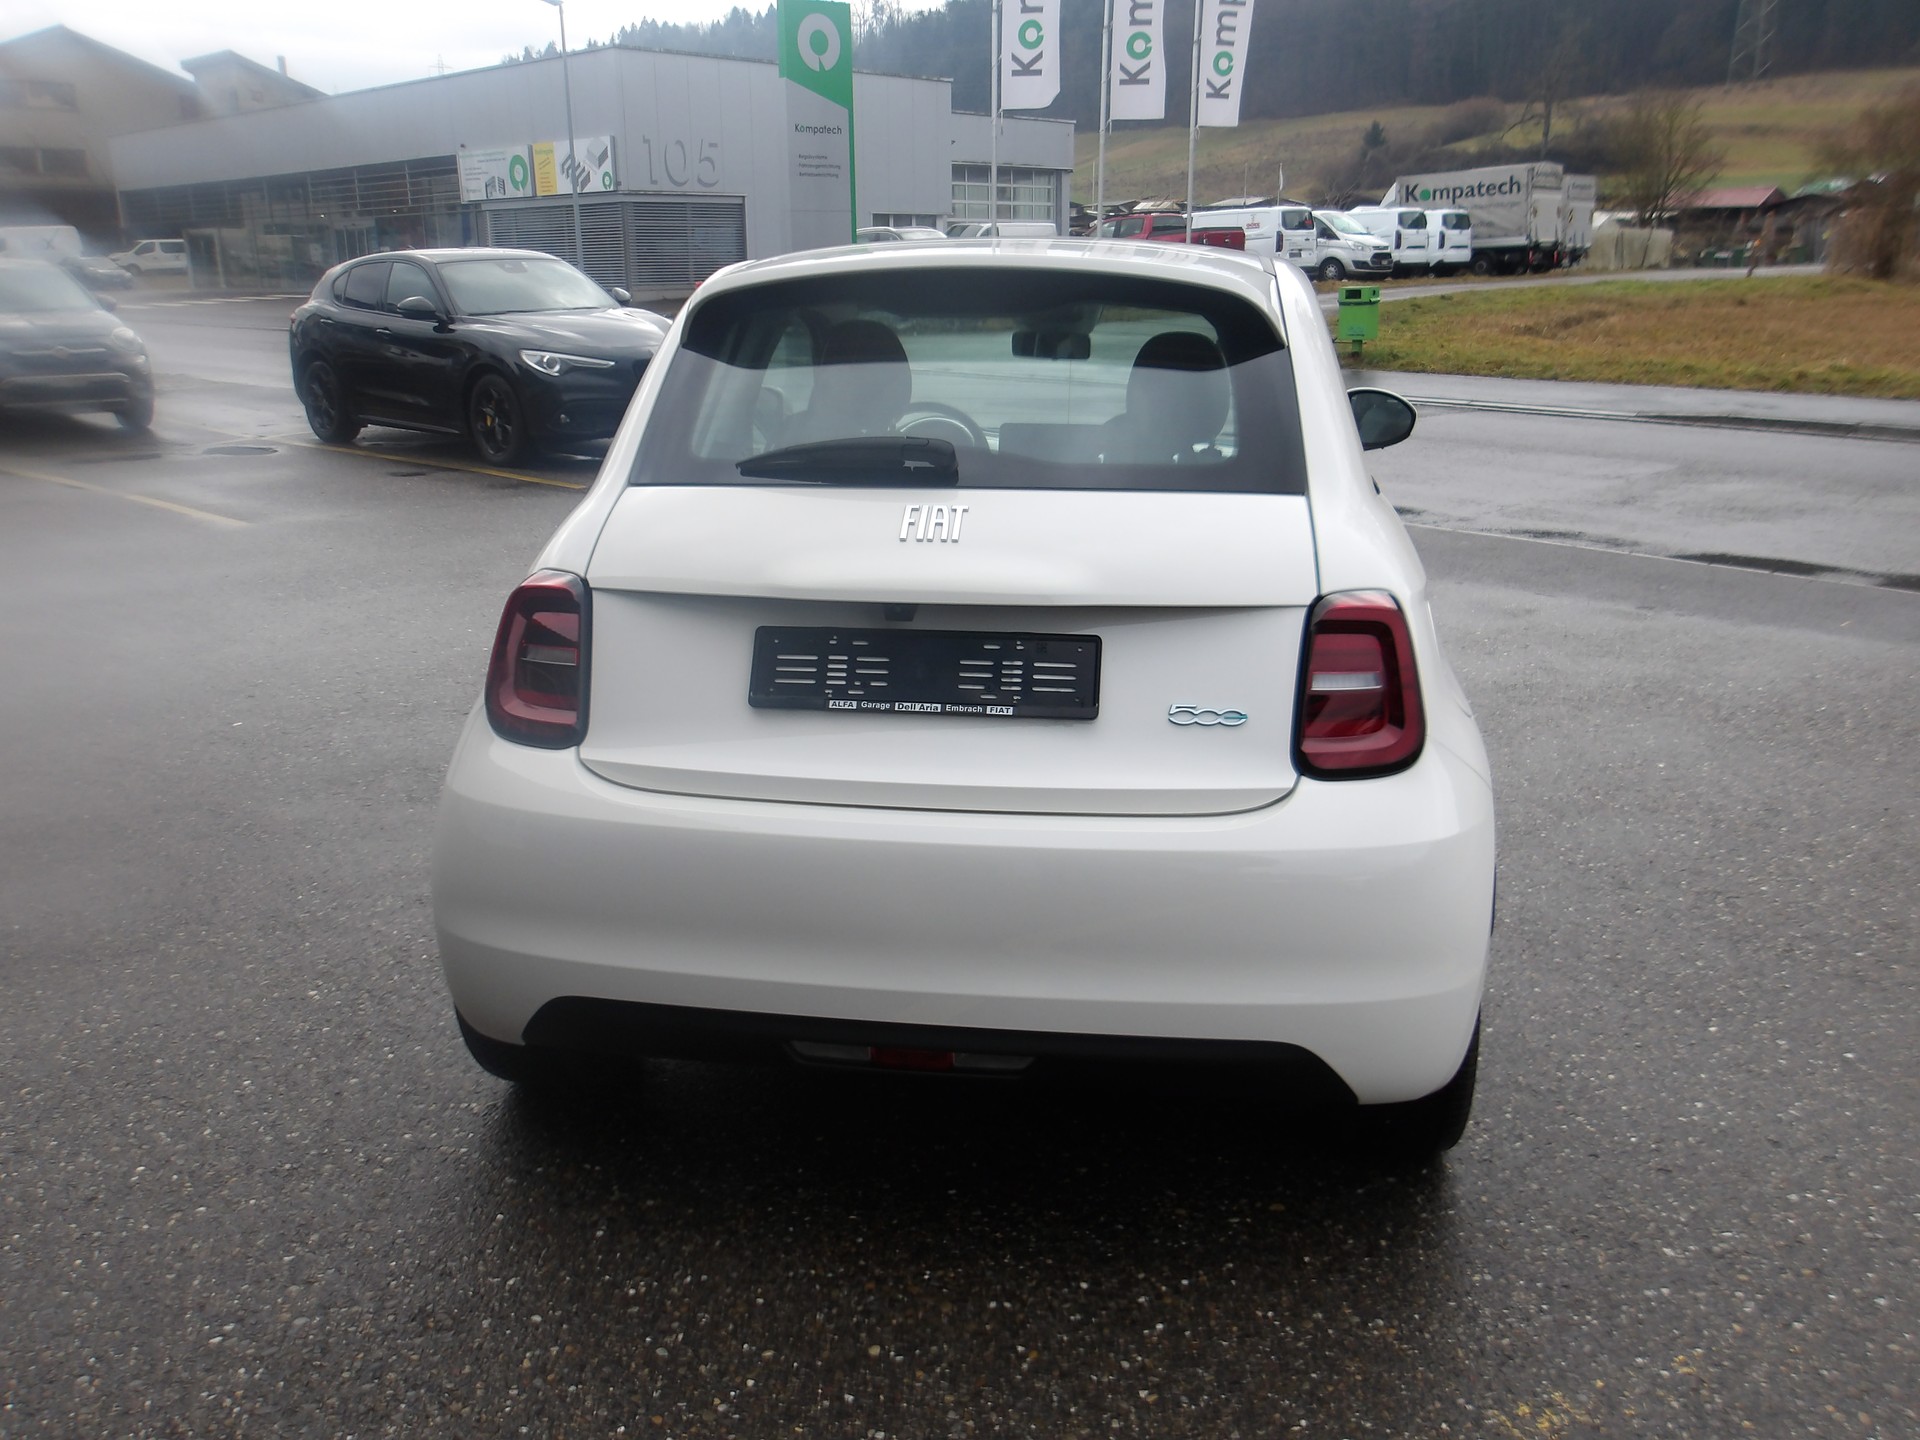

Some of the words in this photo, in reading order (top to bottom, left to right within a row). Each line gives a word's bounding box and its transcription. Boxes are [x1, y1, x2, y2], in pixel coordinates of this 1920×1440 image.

[795, 123, 842, 136] Kompatech
[642, 134, 720, 188] 105
[899, 504, 970, 543] FIAT
[861, 701, 890, 710] Garage
[946, 704, 983, 713] Embrach
[989, 706, 1011, 714] FIAT
